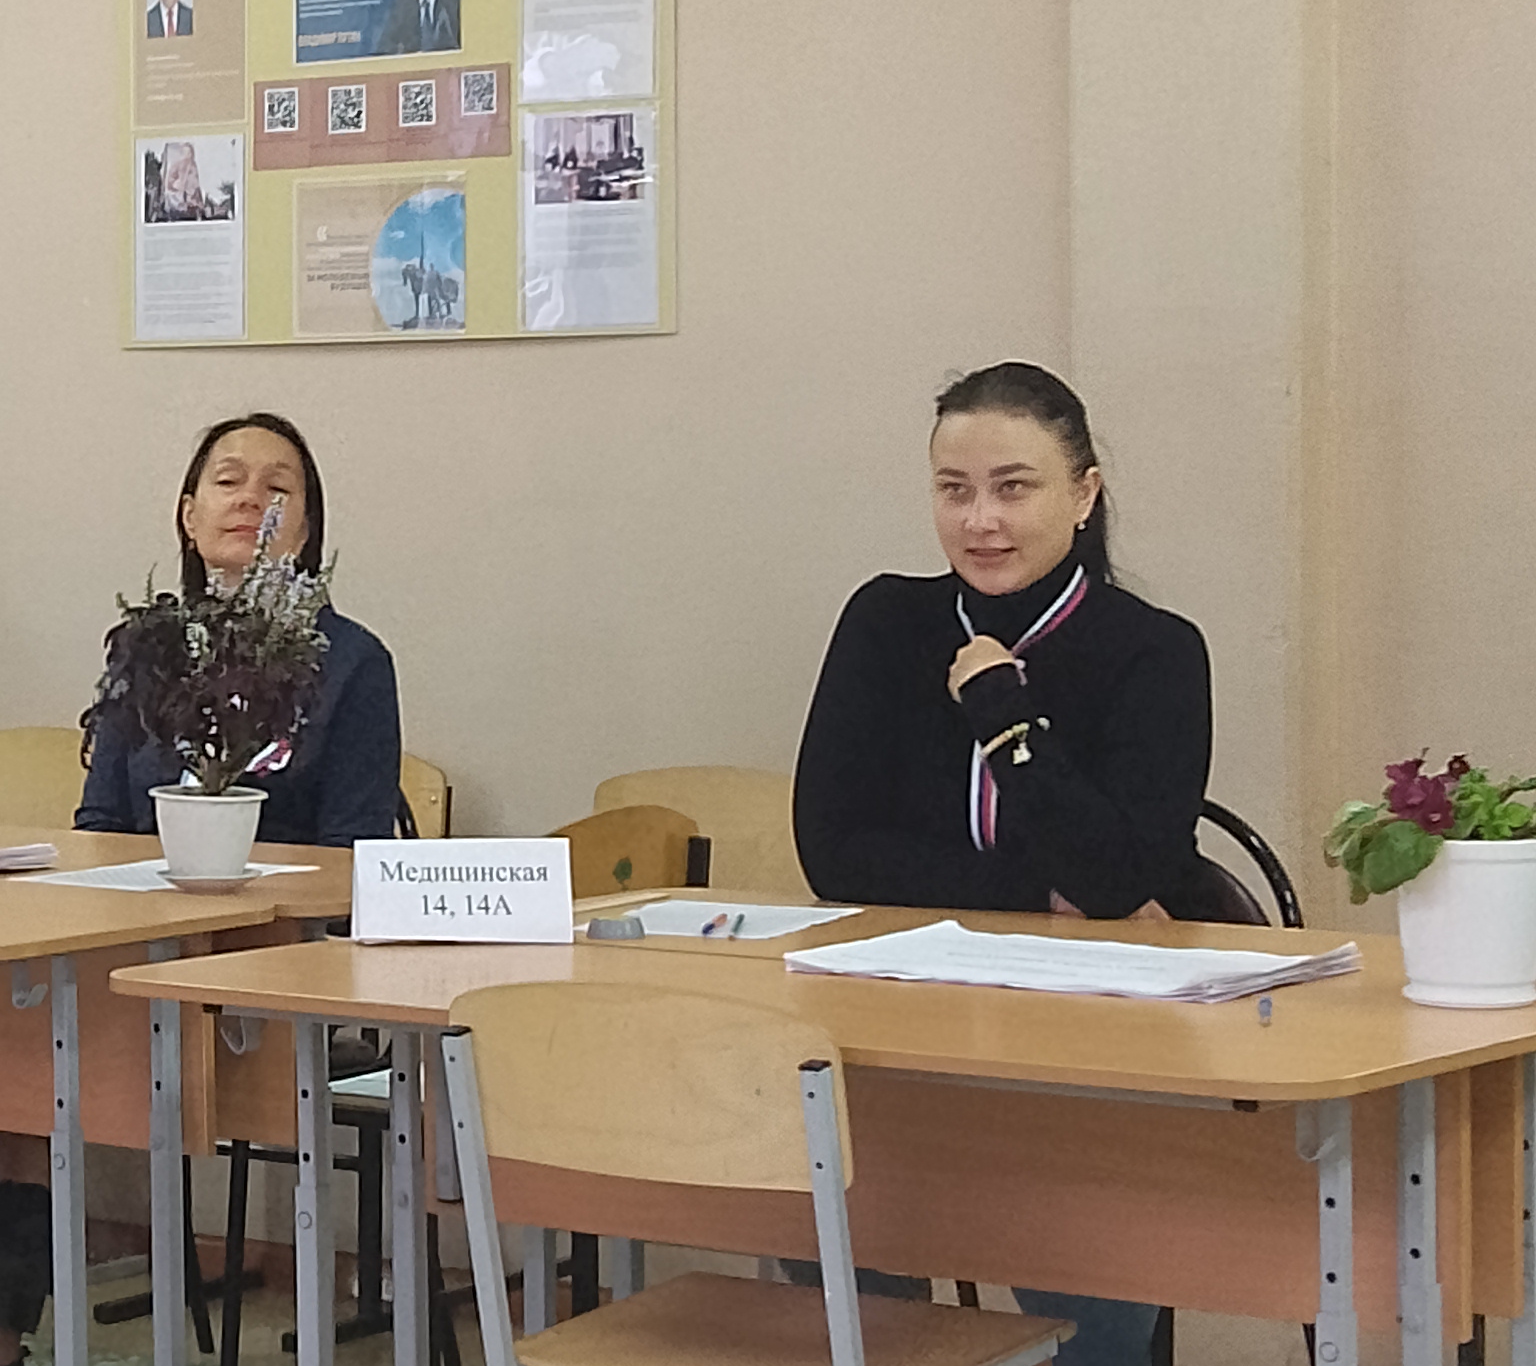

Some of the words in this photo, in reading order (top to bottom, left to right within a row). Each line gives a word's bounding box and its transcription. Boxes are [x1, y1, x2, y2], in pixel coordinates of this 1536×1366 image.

[379, 860, 549, 884] Медицинская
[421, 894, 456, 920] 14,
[464, 894, 513, 916] 14А
